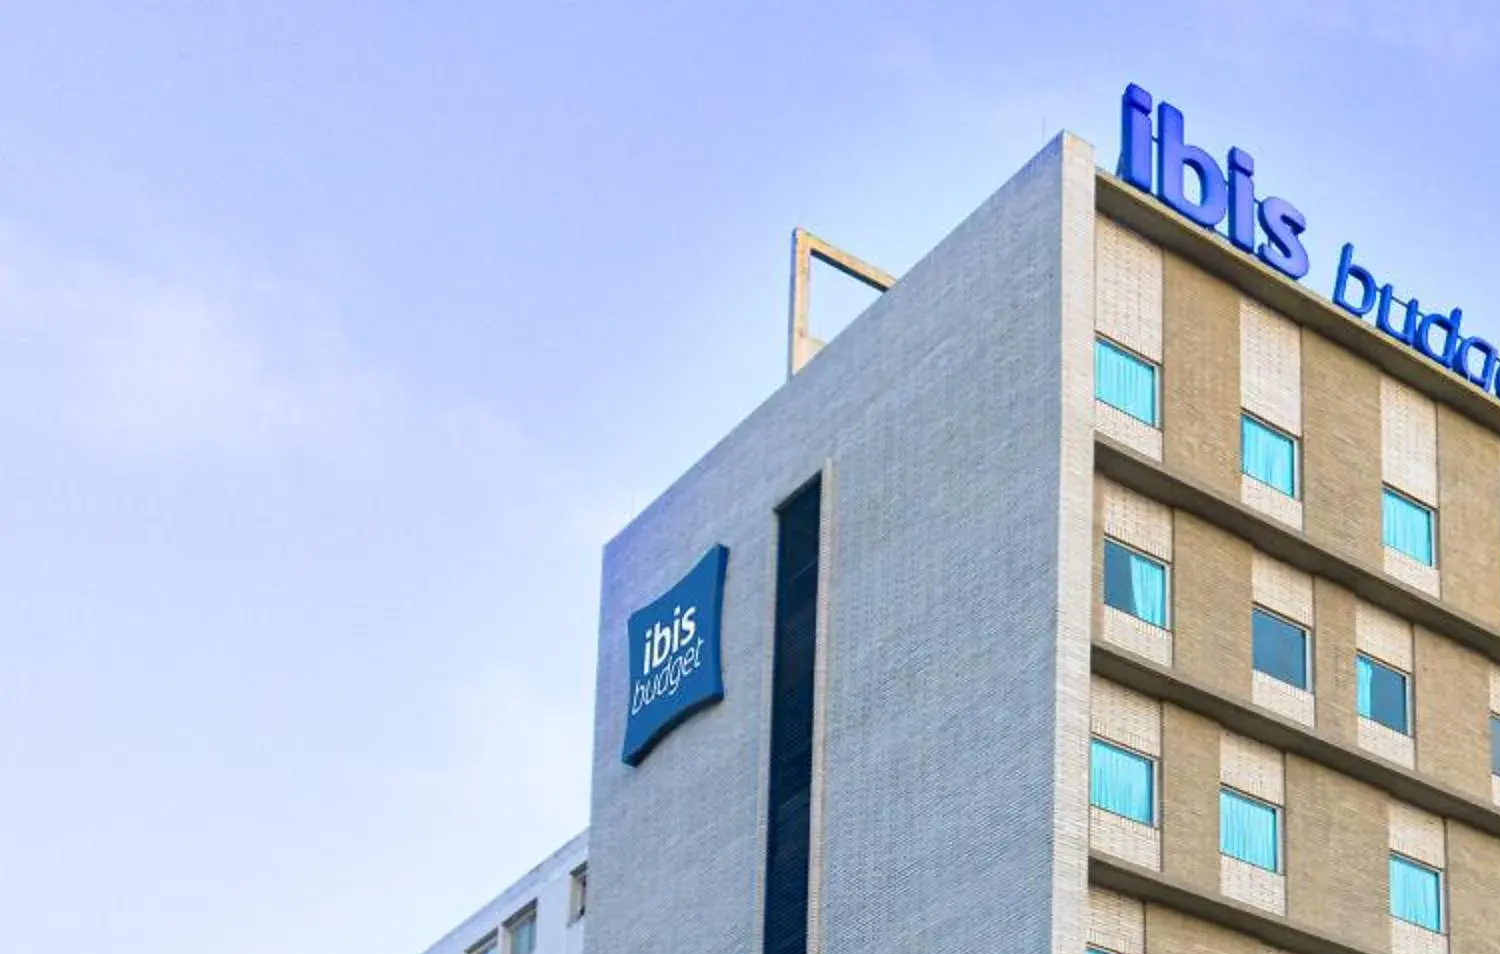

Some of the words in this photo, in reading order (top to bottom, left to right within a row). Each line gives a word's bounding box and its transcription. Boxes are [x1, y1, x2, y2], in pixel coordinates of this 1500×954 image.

[1121, 82, 1310, 280] ibis
[631, 636, 705, 716] budget
[642, 604, 697, 677] ibis
